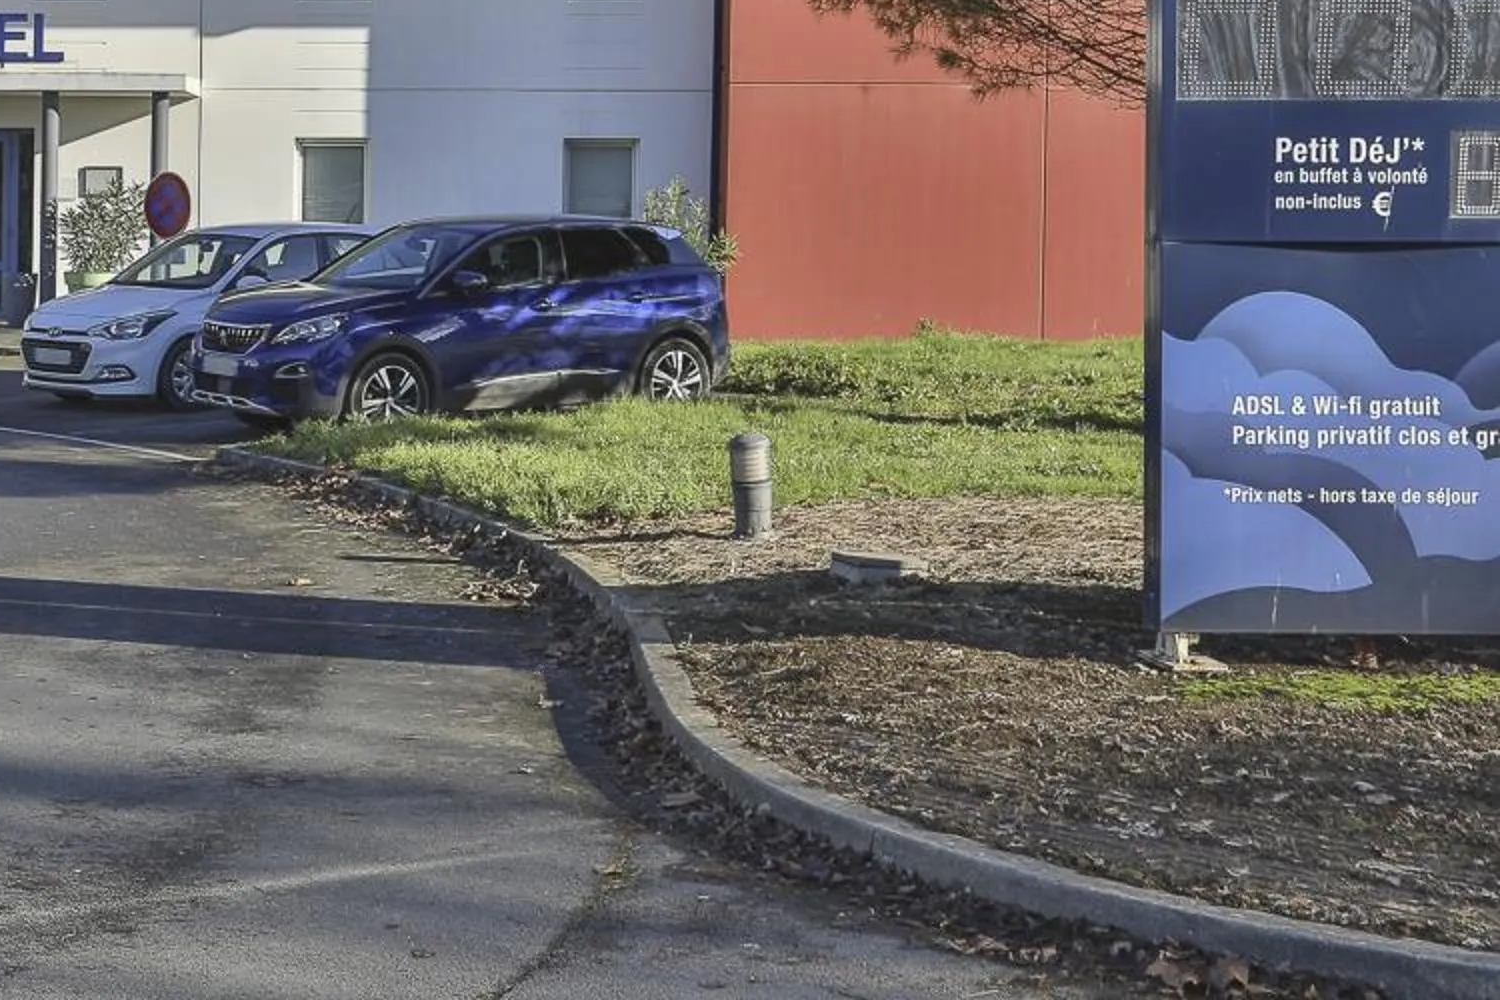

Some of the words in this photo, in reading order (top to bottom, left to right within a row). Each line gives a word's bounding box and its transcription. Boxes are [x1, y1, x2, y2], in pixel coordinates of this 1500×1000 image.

[1275, 136, 1340, 163] Petit
[1274, 170, 1294, 184] en
[1299, 167, 1349, 184] buffet
[1353, 167, 1363, 184] à
[1368, 167, 1428, 184] volonté
[1275, 193, 1362, 210] non-inclus
[1372, 191, 1393, 217] €
[1232, 396, 1285, 415] ADSL
[1291, 396, 1307, 415] &
[1313, 395, 1362, 415] Wi-fi
[1369, 396, 1441, 420] gratuit
[1232, 425, 1309, 449] Parking
[1317, 425, 1391, 449] privatif
[1398, 426, 1441, 446] clos
[1448, 426, 1469, 446] et
[1476, 430, 1500, 450] gr
[1268, 488, 1302, 503] nets
[1320, 488, 1357, 504] hors
[1361, 489, 1396, 504] taxe
[1402, 488, 1421, 504] de
[1427, 488, 1479, 506] séjour
